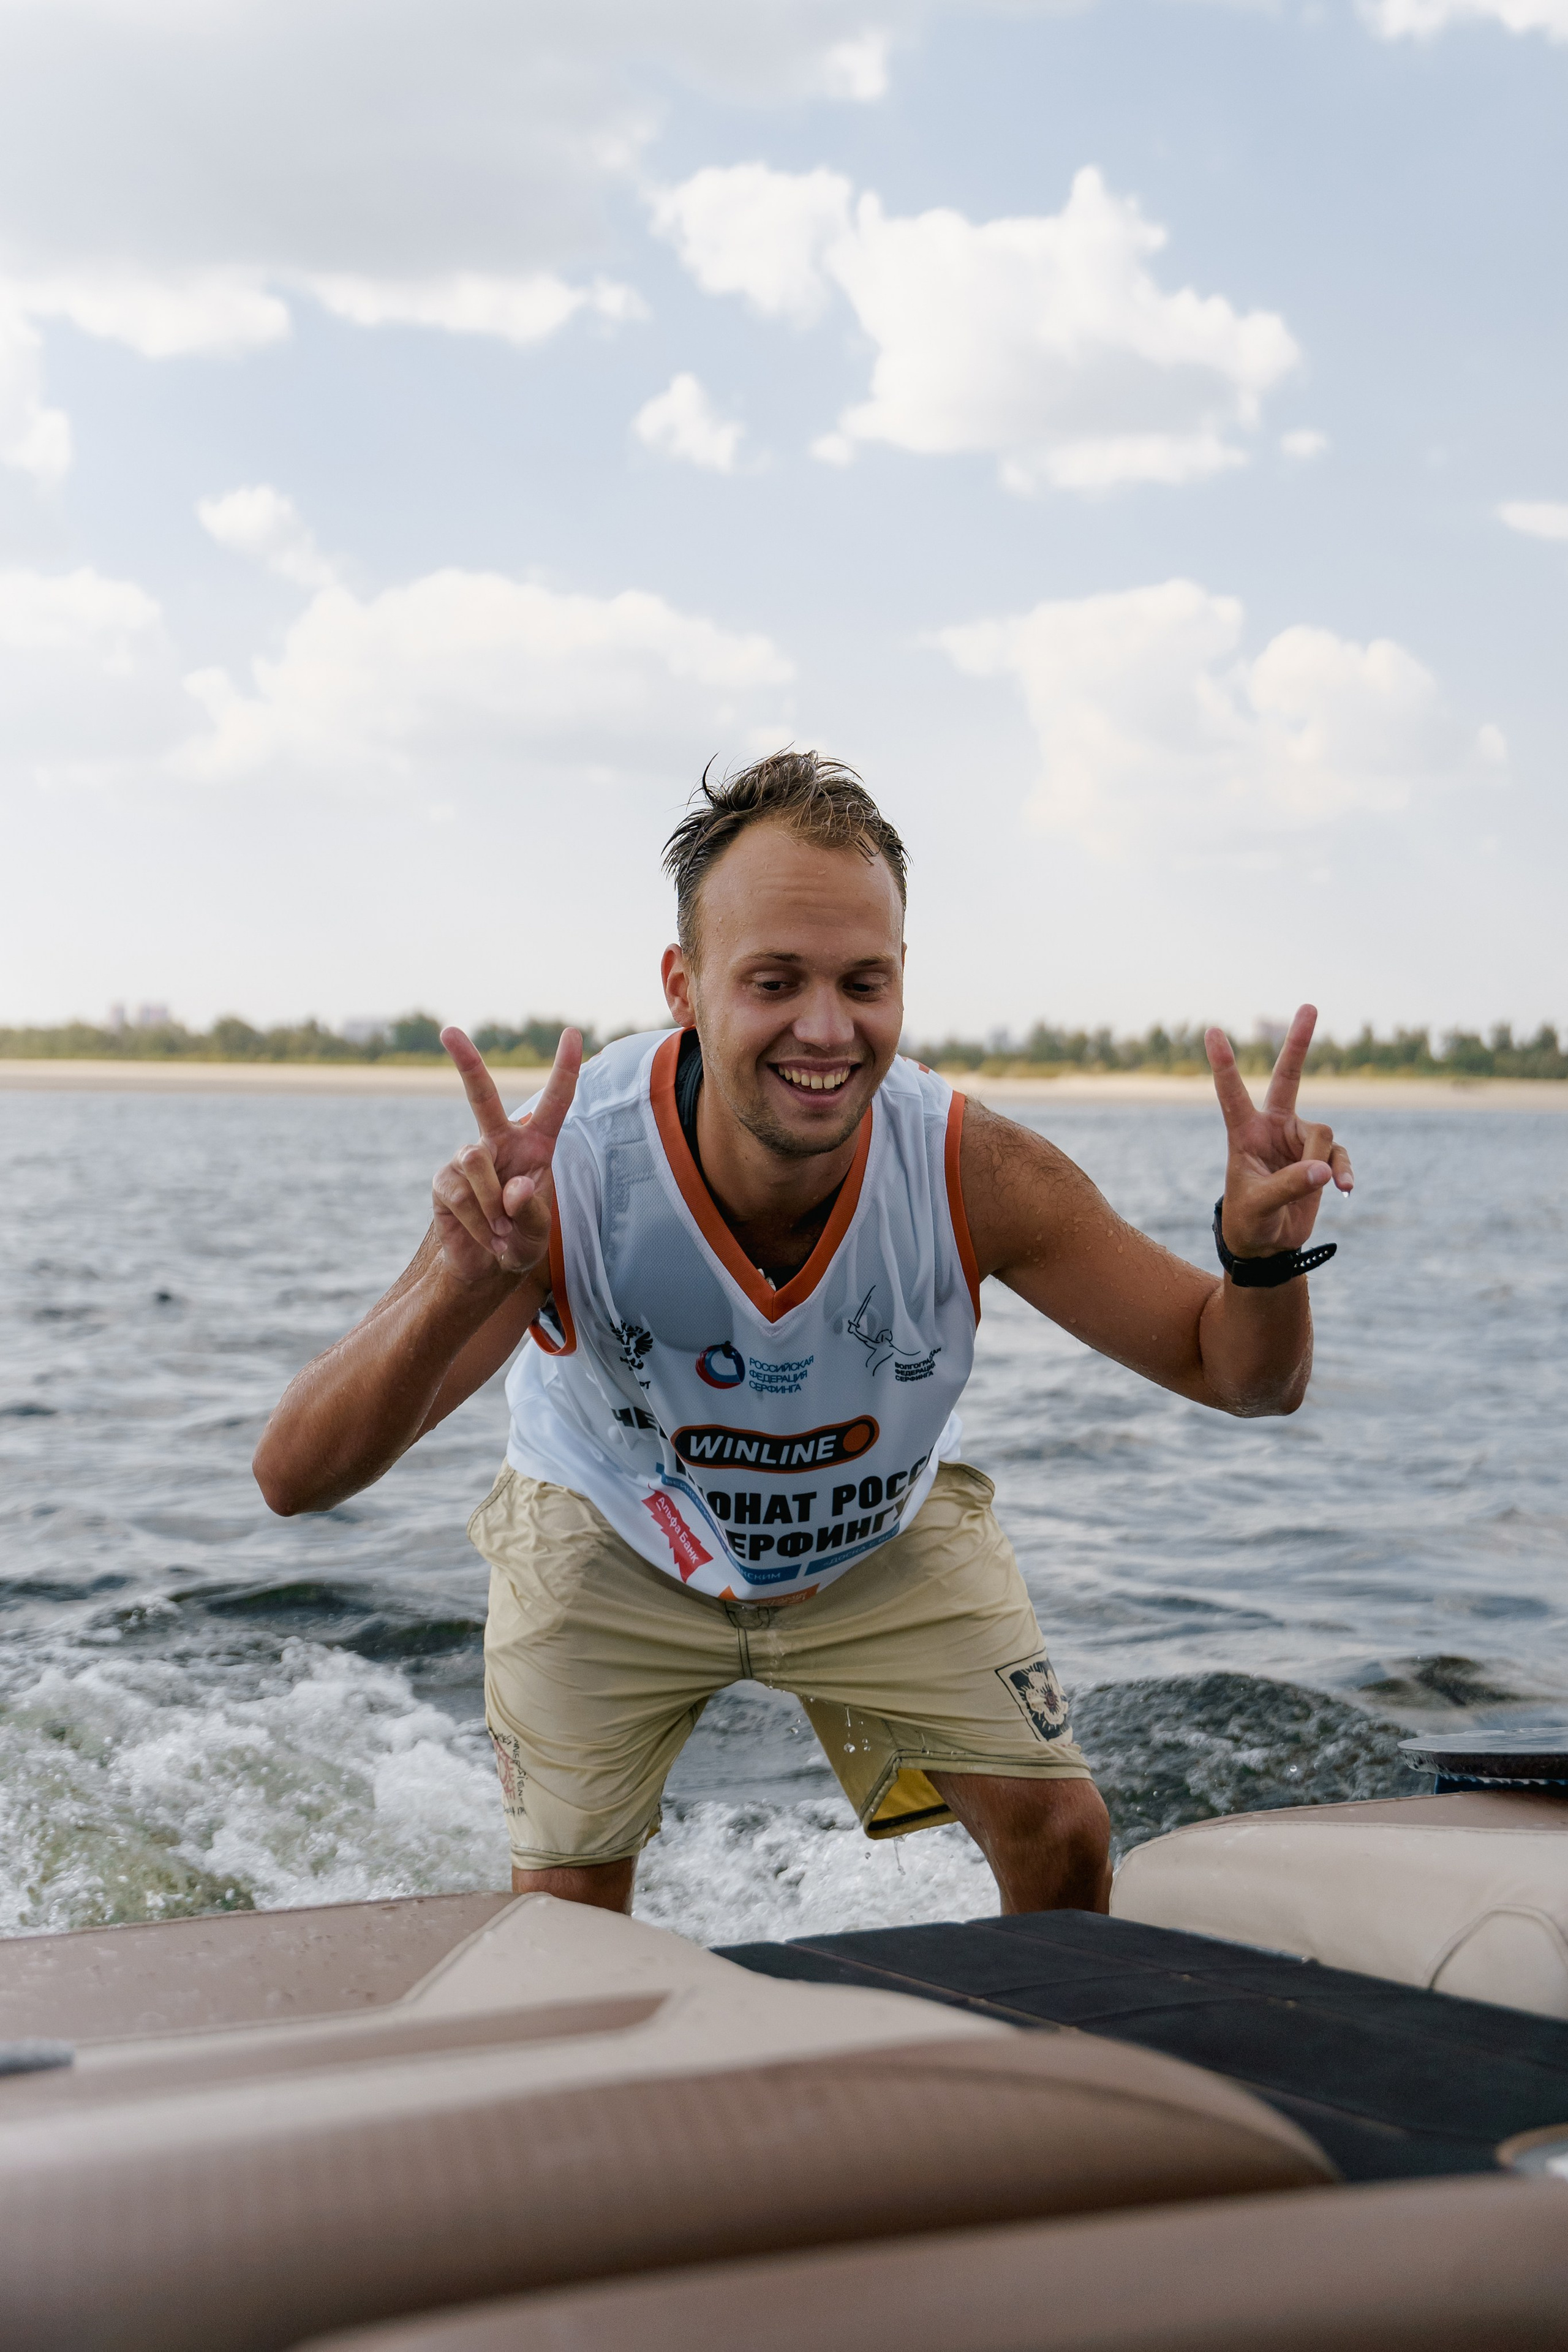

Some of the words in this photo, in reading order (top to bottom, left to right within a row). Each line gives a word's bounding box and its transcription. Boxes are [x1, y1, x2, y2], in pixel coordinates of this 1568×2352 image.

[749, 1355, 814, 1373] РОССИЙСКАЯ
[895, 1370, 934, 1382] СЕРФИНГА
[748, 1380, 802, 1394] СЕРФИНГА
[749, 1369, 808, 1384] ФЕДЕРАЦИЯ
[690, 1434, 837, 1465] WINLINE
[704, 1490, 817, 1525] ОНАТ
[831, 1449, 932, 1517] РОСС
[656, 1496, 680, 1535] Альфа
[679, 1532, 699, 1564] Банк
[724, 1493, 913, 1561] ЕРФИНГУ
